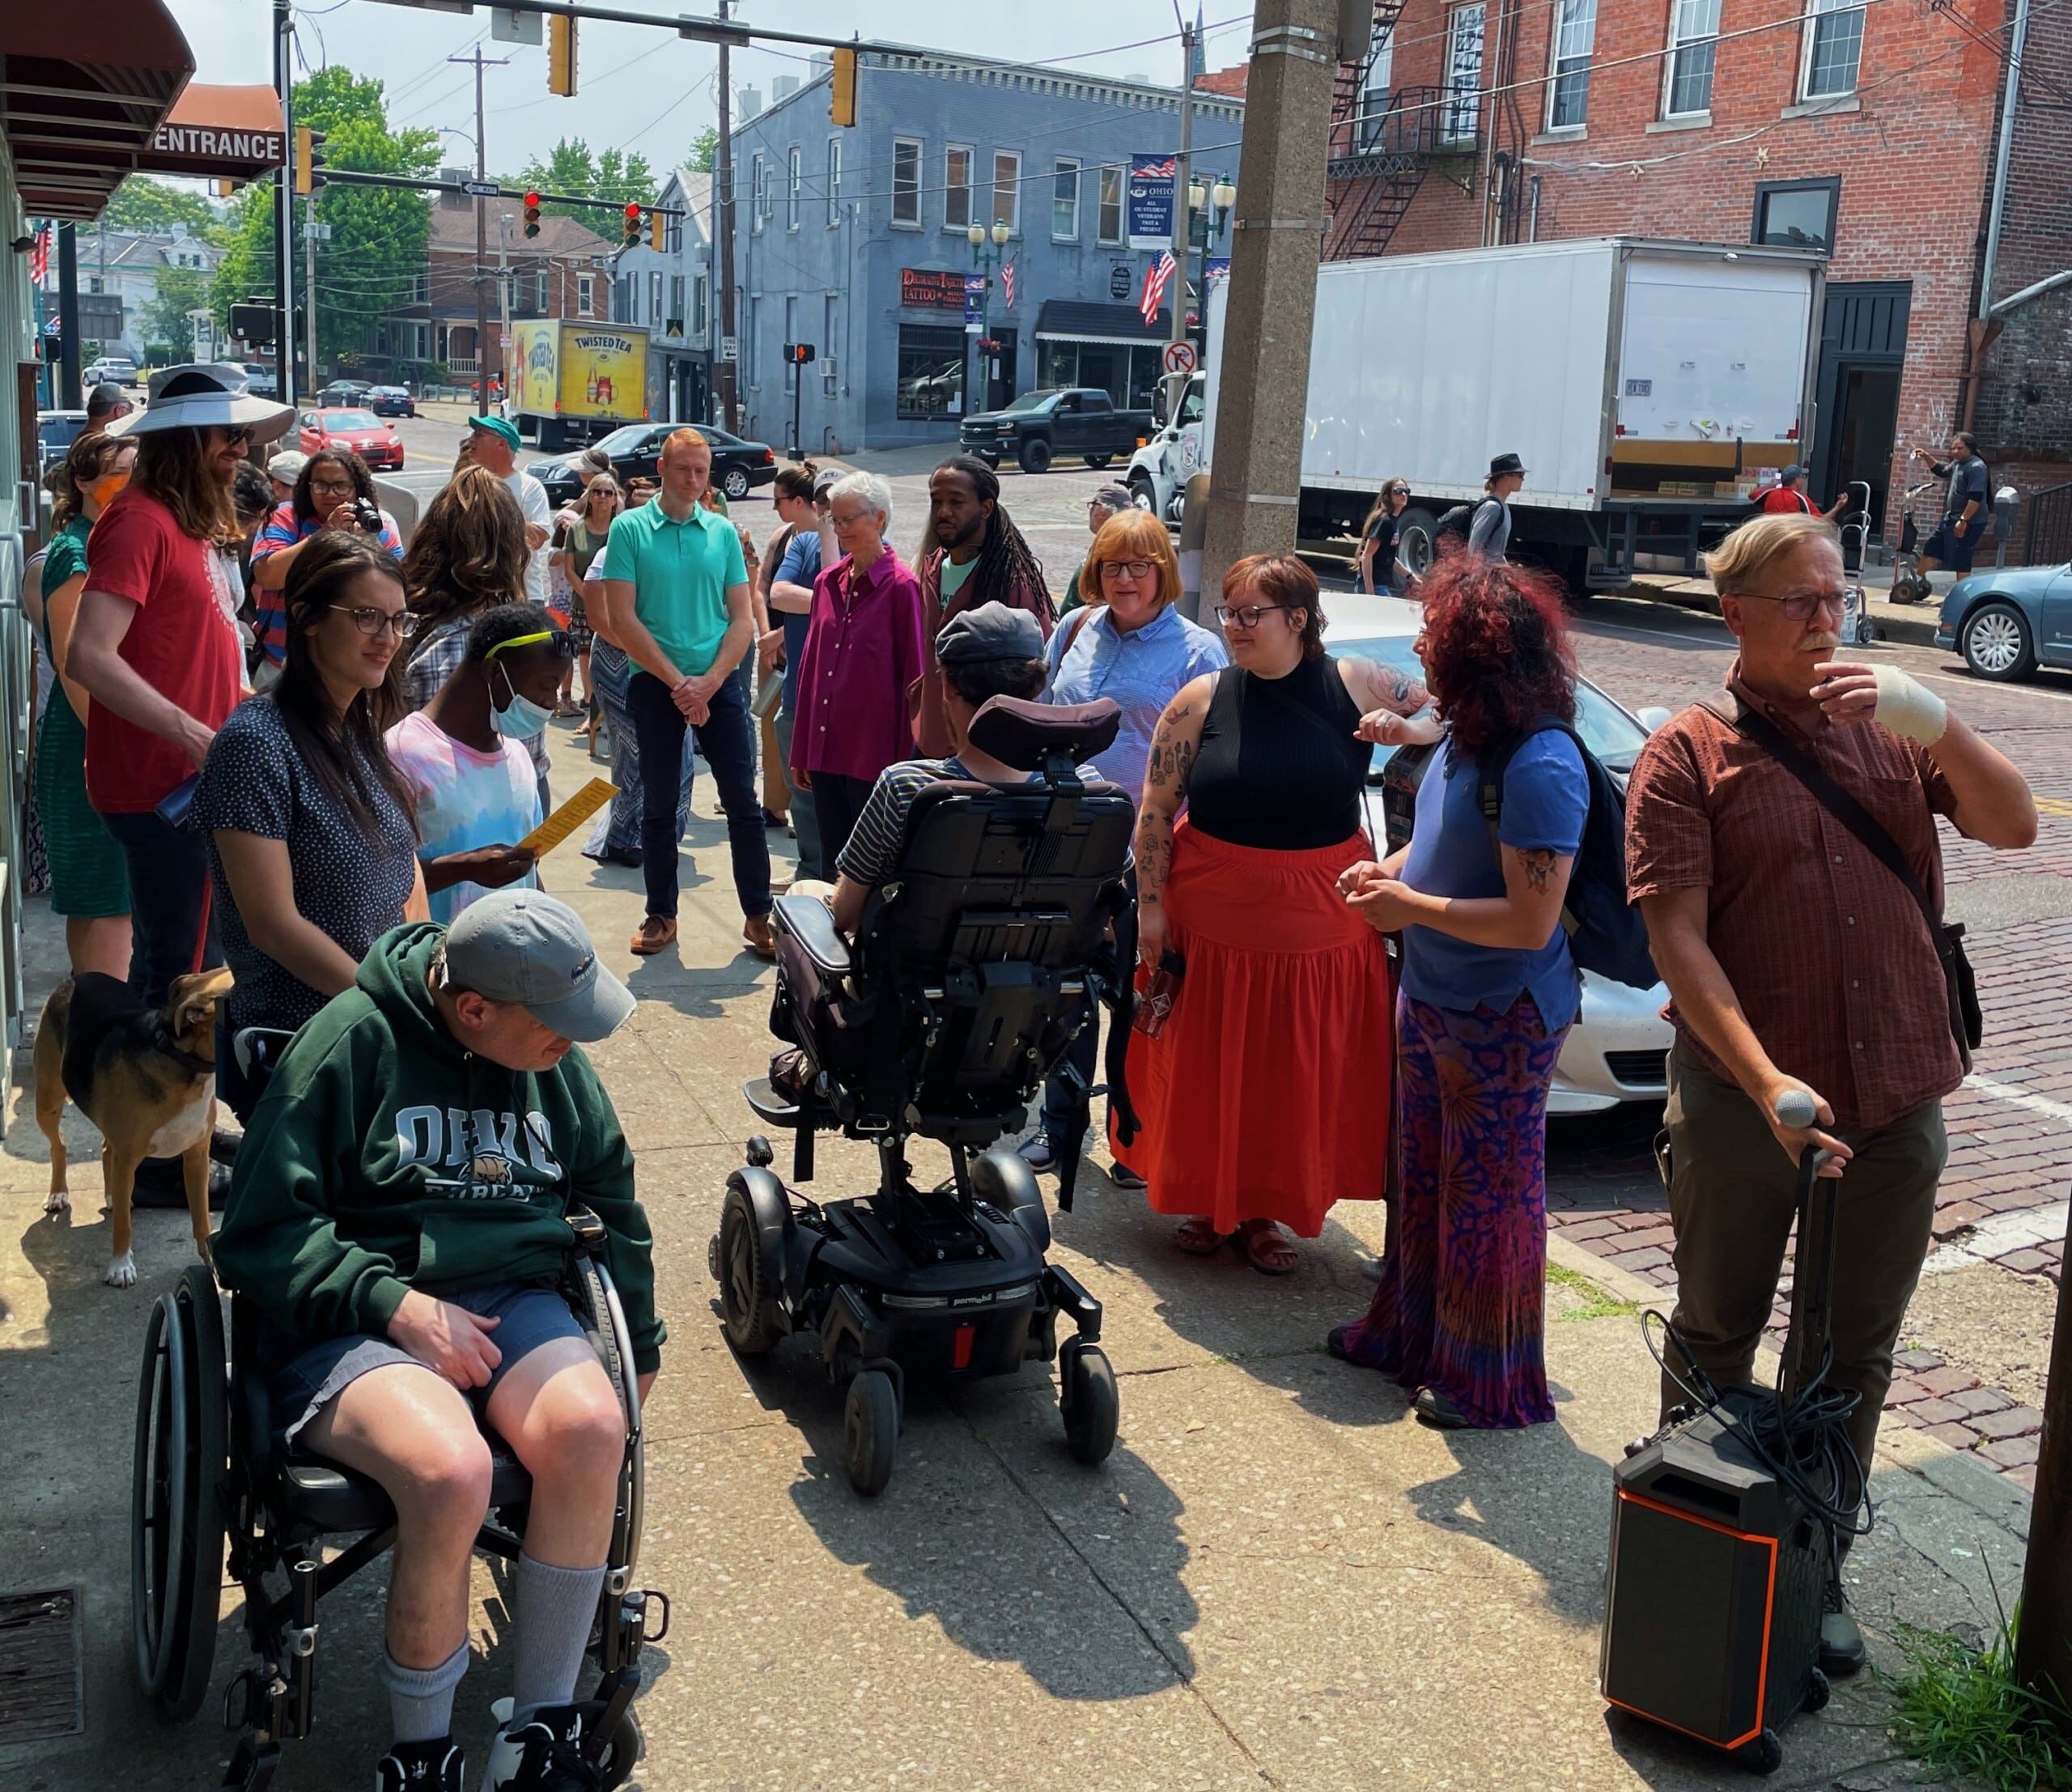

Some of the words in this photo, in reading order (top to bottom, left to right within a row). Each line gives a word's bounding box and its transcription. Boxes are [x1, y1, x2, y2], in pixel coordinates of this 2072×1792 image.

[154, 126, 280, 160] ENTRANCE
[1149, 187, 1174, 195] OHIO
[904, 287, 936, 300] TATTOO
[575, 337, 614, 349] TWISTED
[615, 338, 632, 354] TEA
[396, 1105, 563, 1182] OHIO
[953, 1293, 992, 1306] permobil
